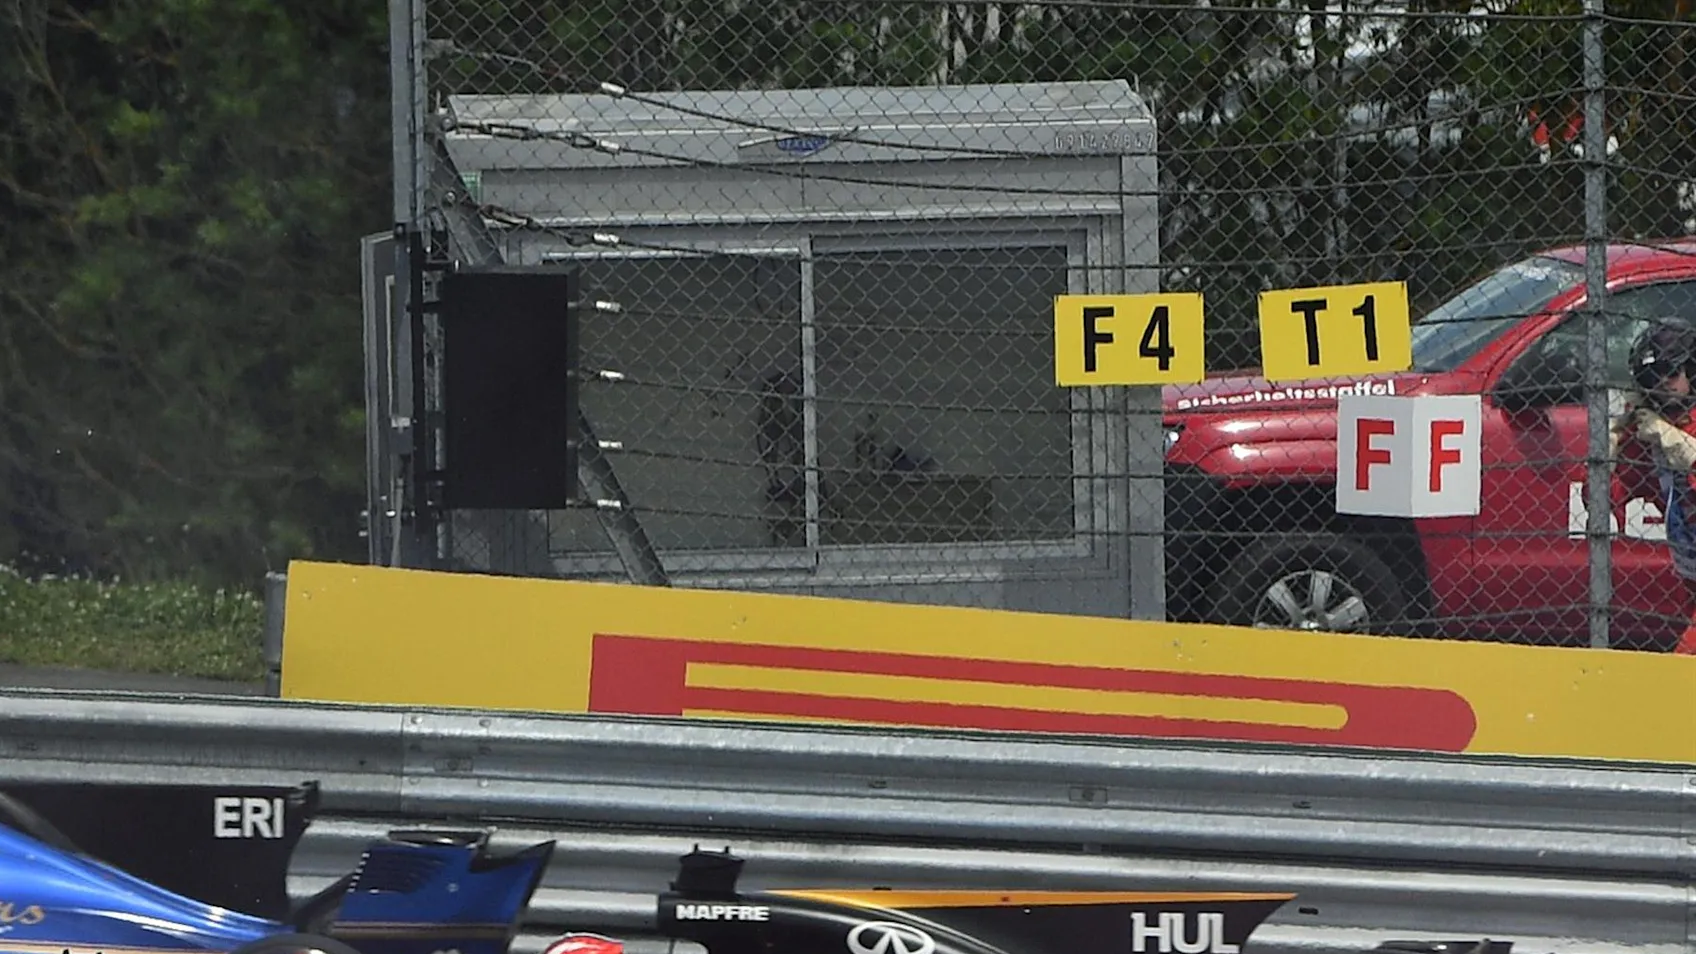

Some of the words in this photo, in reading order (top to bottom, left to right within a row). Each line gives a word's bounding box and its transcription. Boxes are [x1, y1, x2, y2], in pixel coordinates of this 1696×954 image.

[1083, 306, 1115, 372] F
[1139, 306, 1174, 372] 4
[1291, 300, 1328, 366] T
[1352, 295, 1379, 361] 1
[1355, 418, 1395, 491] F
[1429, 420, 1464, 492] F
[213, 796, 285, 839] ERI
[675, 904, 771, 922] MAPFRE
[1130, 911, 1241, 954] HUL
